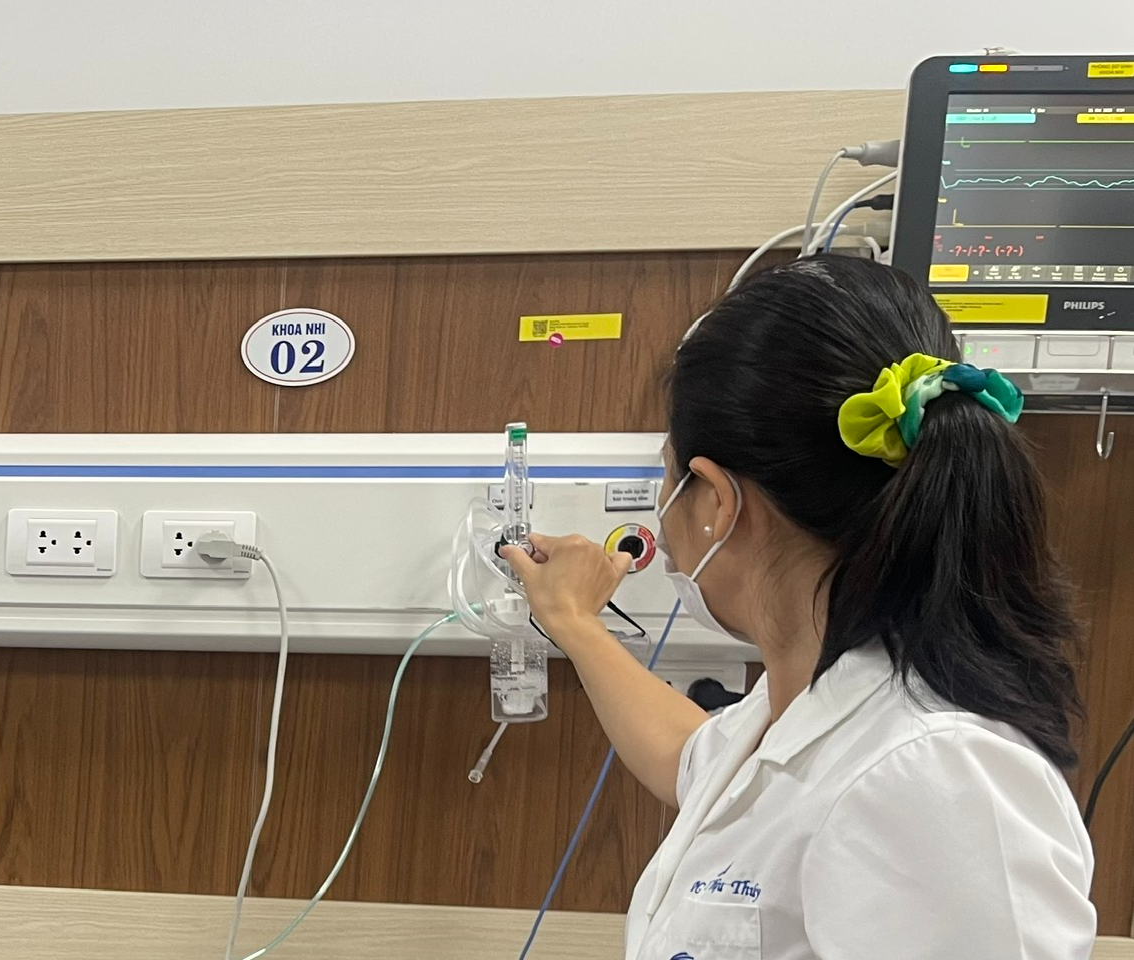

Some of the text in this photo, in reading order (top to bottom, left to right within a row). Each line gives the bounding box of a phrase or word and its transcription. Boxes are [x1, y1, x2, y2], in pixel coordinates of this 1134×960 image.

[1063, 301, 1105, 310] PHILIPS
[272, 322, 326, 336] KHOA NHI
[270, 339, 325, 375] 02
